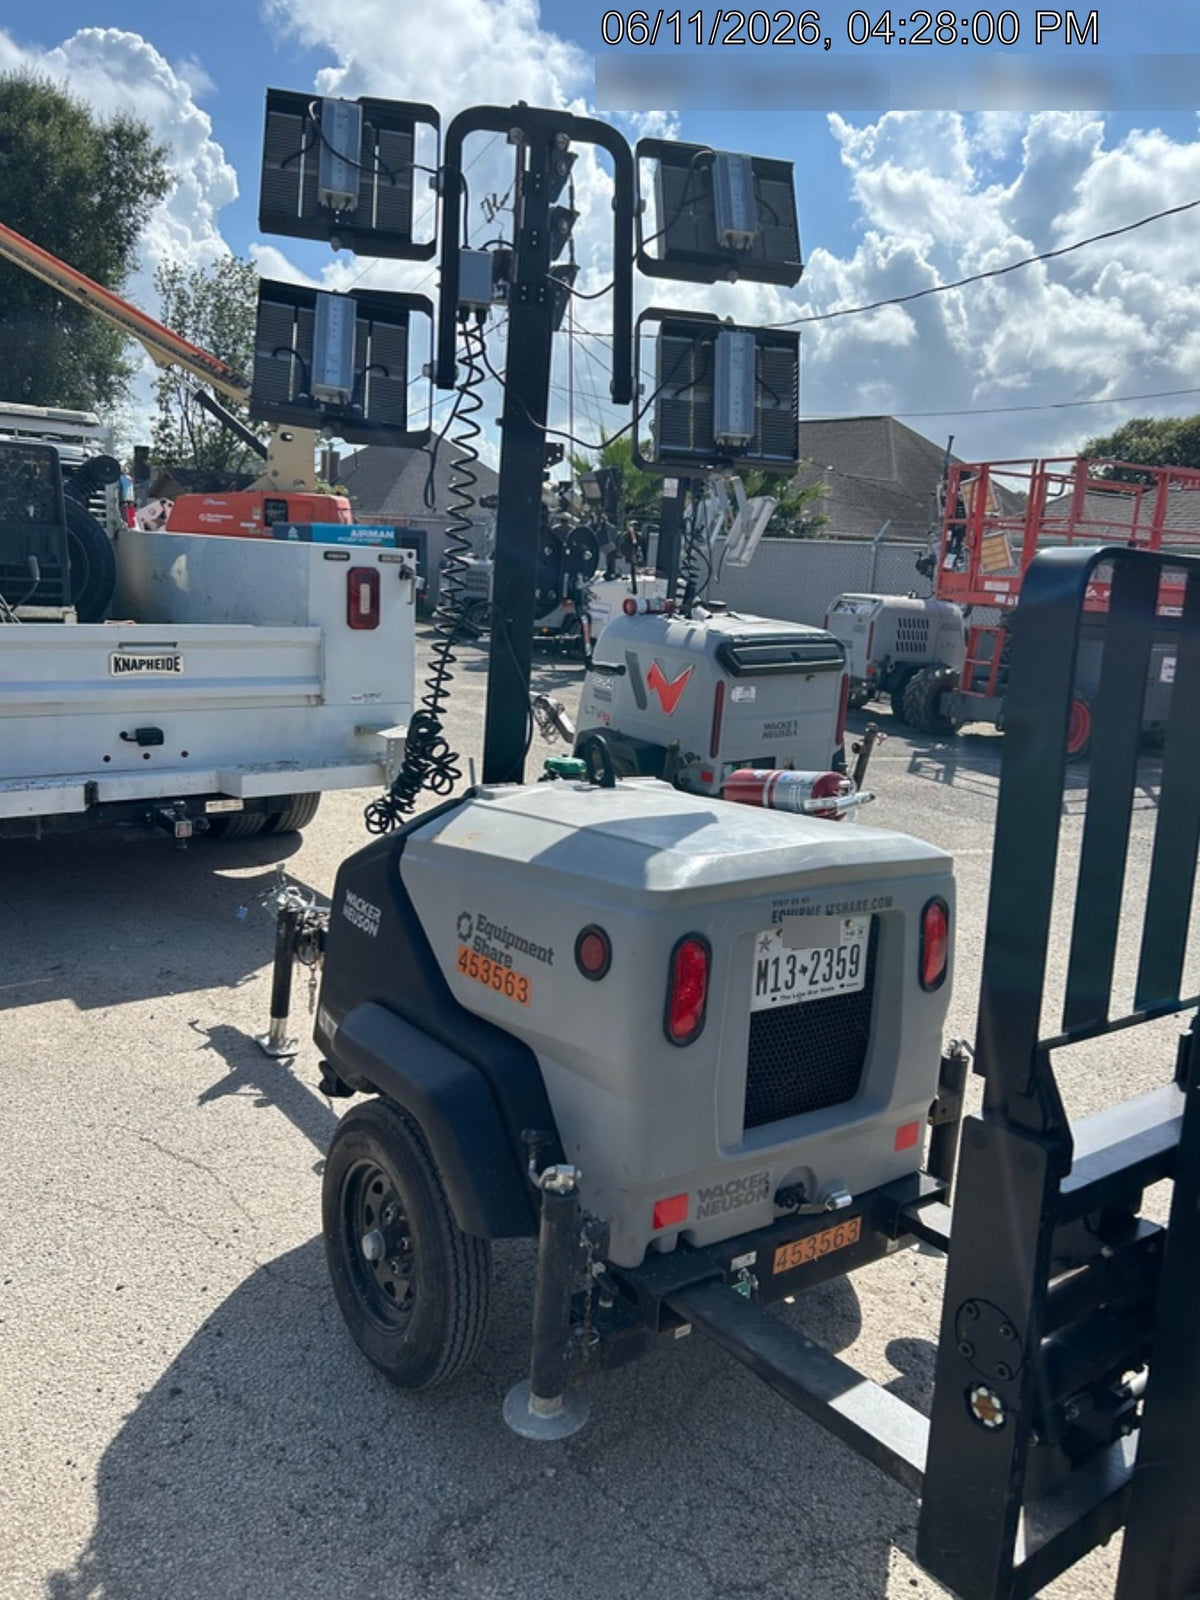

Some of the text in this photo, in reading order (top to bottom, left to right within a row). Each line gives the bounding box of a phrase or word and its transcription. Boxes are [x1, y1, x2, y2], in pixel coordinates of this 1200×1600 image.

[113, 655, 181, 673] KNAPHEIDE
[342, 902, 380, 938] NEUSON
[345, 889, 382, 922] WACKER
[475, 913, 554, 966] Equipment
[458, 949, 529, 1003] 453563
[696, 1187, 769, 1220] NEUSON
[697, 1171, 770, 1202] WACKER
[776, 1220, 859, 1269] 453563
